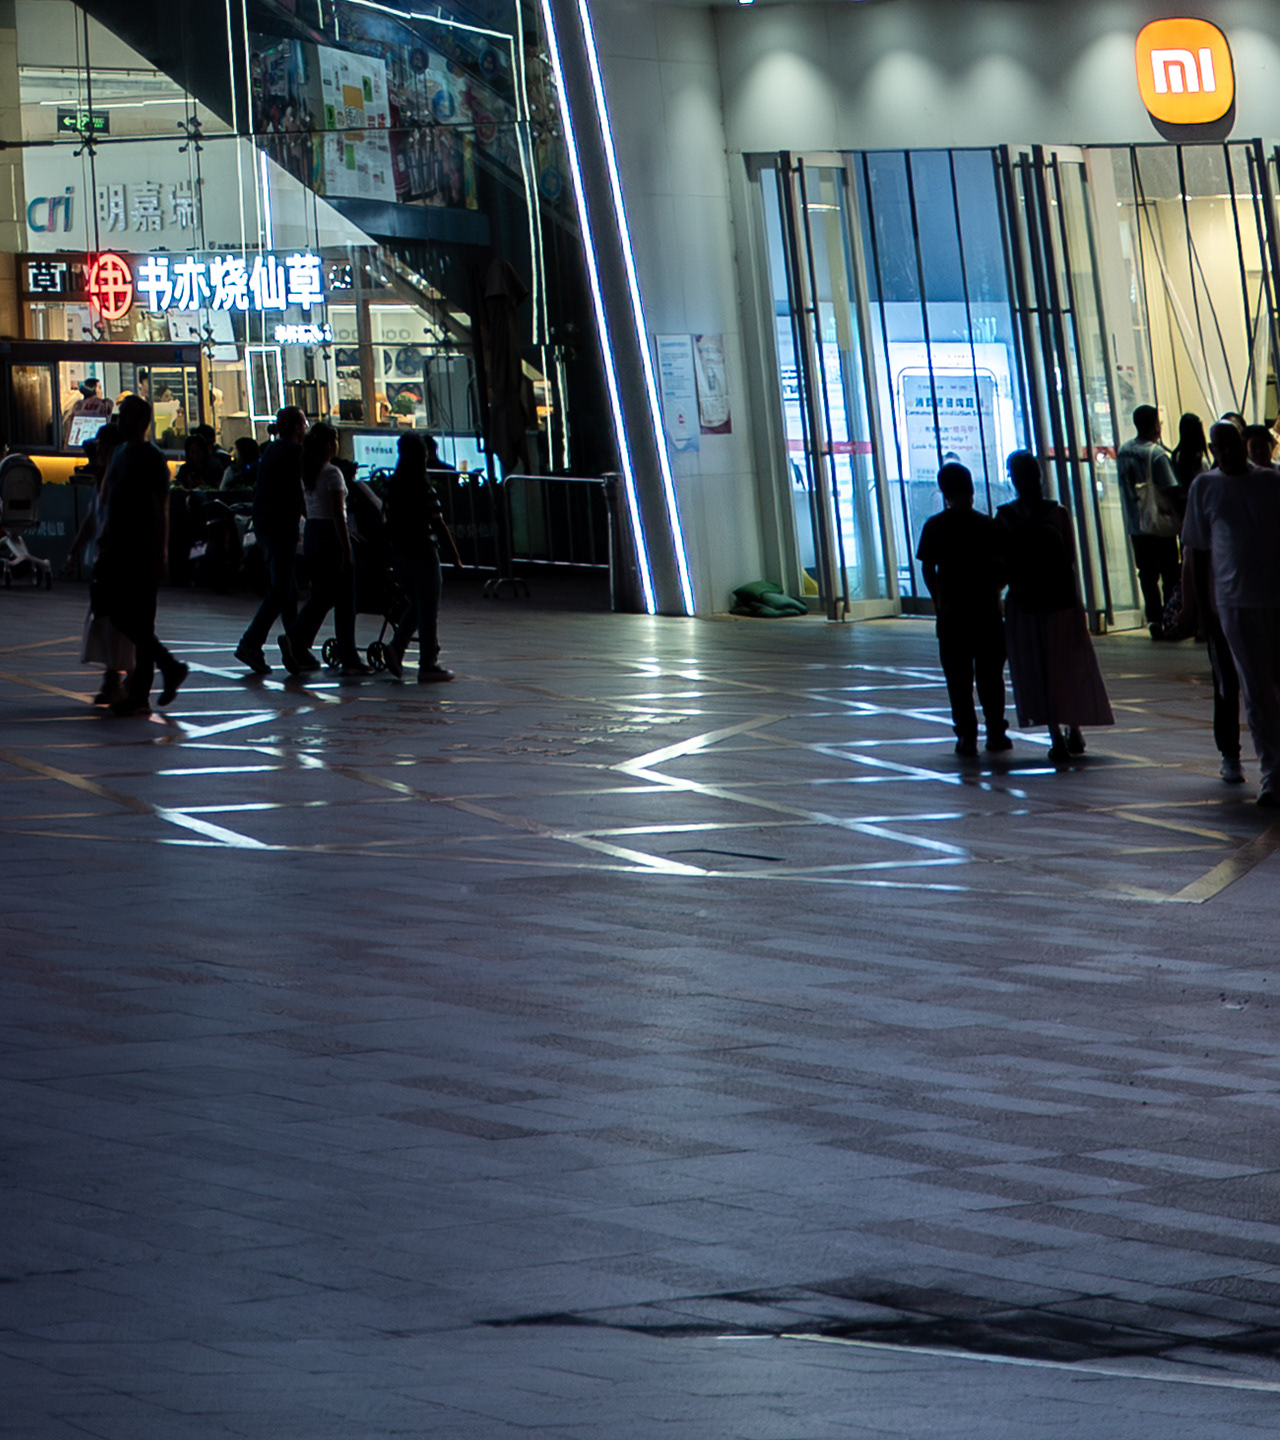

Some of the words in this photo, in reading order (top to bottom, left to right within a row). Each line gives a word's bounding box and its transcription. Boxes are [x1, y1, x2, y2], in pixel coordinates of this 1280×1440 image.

[98, 181, 202, 232] 明嘉瑞
[137, 252, 325, 313] 书亦烧仙草
